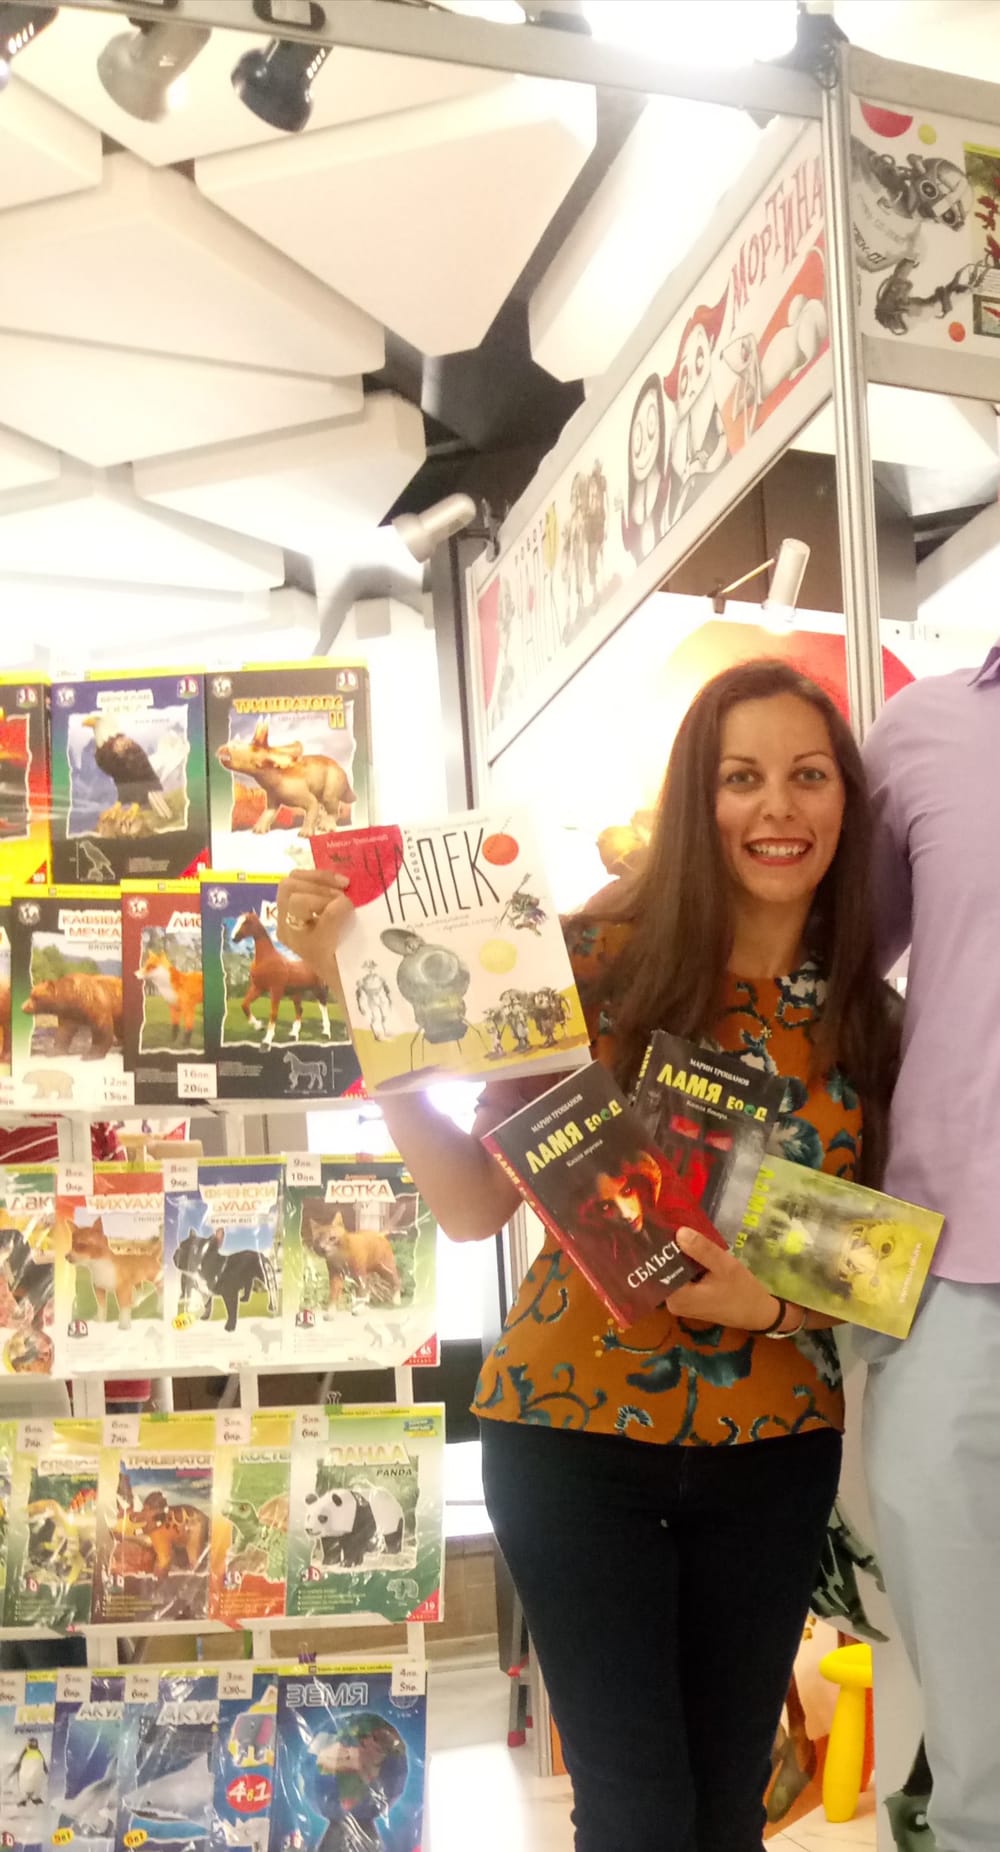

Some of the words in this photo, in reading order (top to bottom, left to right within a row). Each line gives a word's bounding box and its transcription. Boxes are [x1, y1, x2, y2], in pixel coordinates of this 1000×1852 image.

[731, 157, 826, 316] МОРТИНА
[656, 1062, 724, 1105] ЛАМЯ
[524, 1120, 585, 1175] ЛАМЯ
[330, 1184, 392, 1198] КОТКА
[626, 1240, 681, 1289] СБЛЪС
[328, 1446, 406, 1464] ПАНДА
[375, 1468, 413, 1478] PANDA
[286, 1681, 370, 1708] ЗЕМЯ
[160, 1703, 220, 1726] АКУЛ
